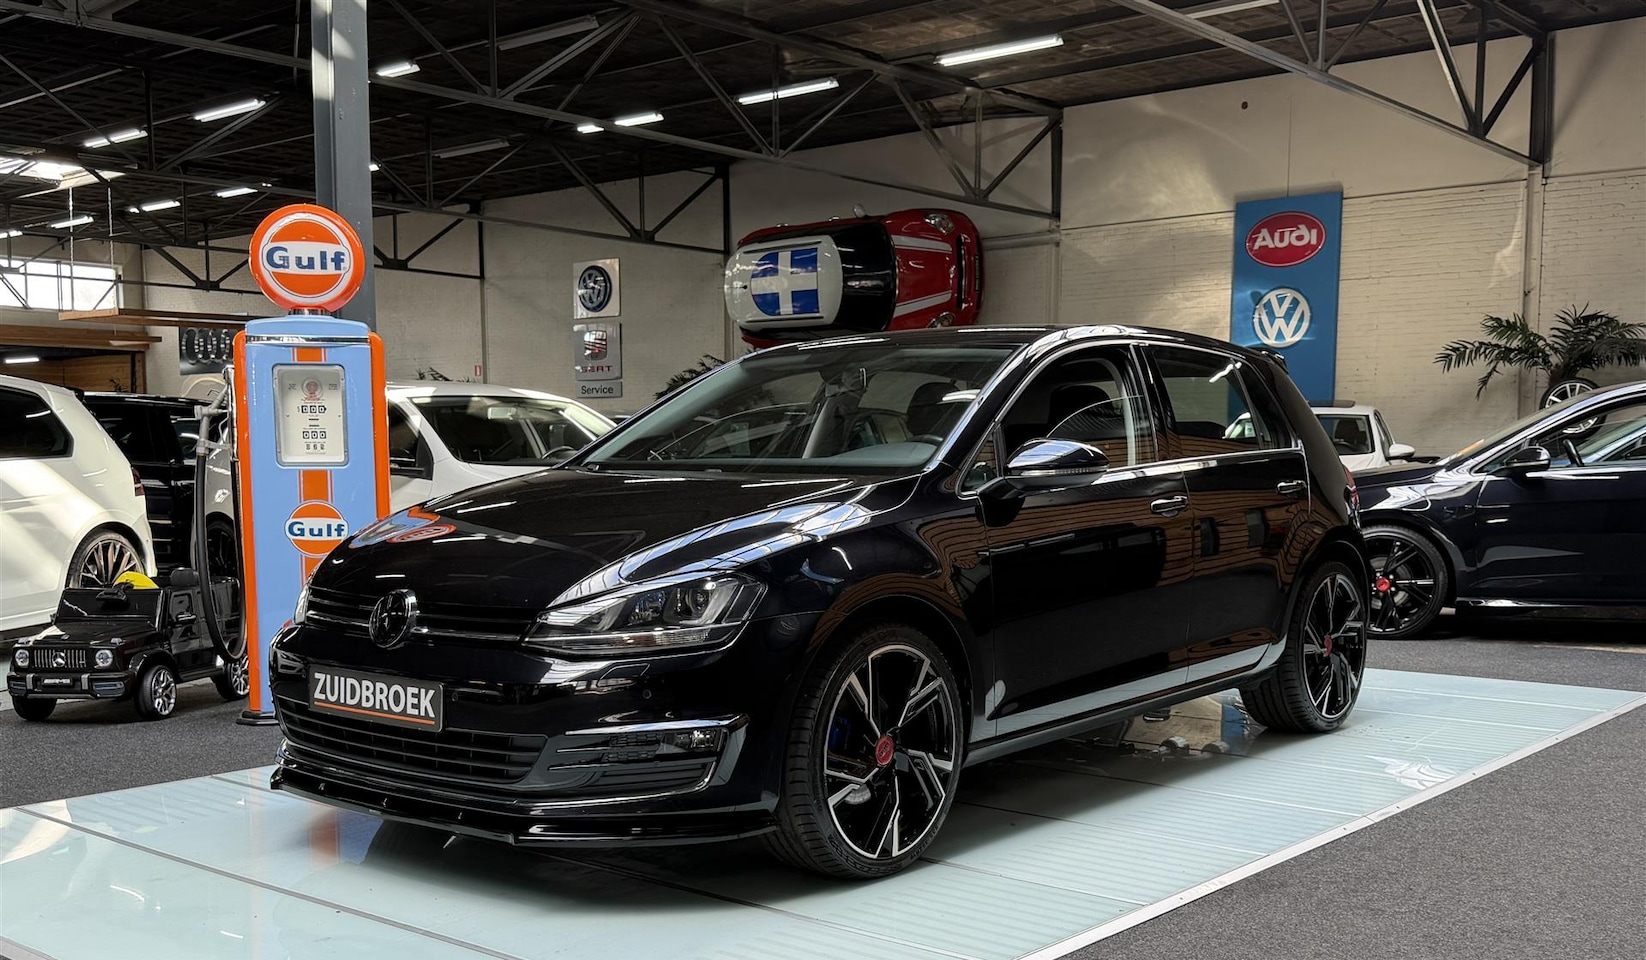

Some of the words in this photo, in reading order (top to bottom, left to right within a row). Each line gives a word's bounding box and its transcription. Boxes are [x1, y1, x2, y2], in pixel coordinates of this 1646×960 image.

[266, 246, 345, 271] Gulf
[580, 365, 613, 373] SEAT
[580, 385, 614, 394] Service
[288, 521, 345, 537] Gulf
[313, 672, 435, 718] ZUIDBROEK
